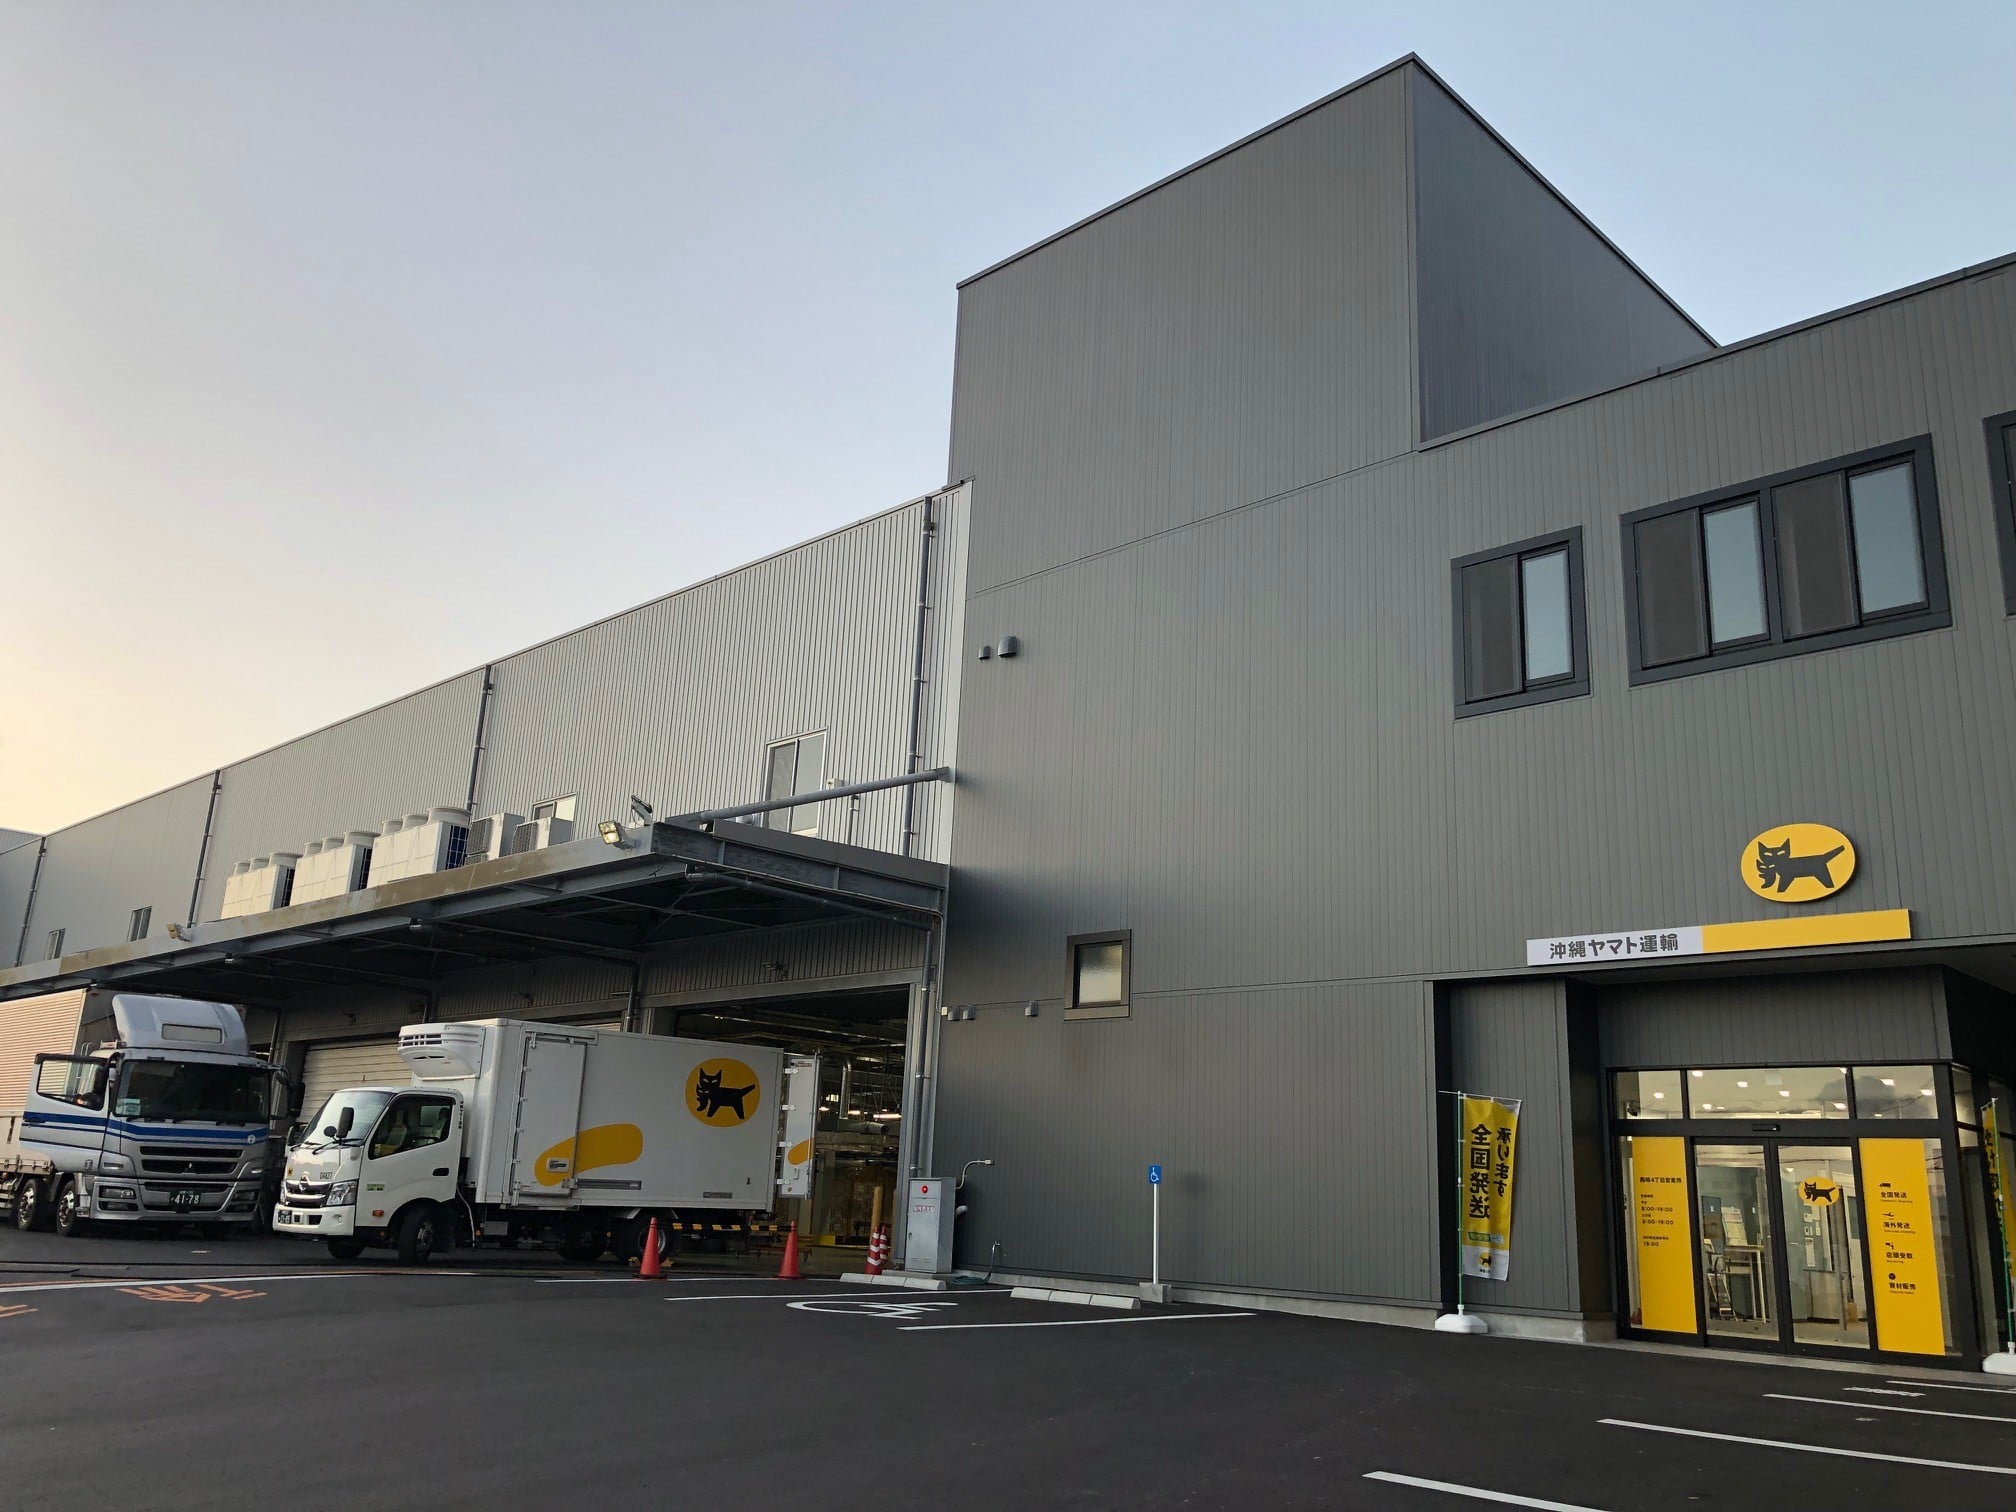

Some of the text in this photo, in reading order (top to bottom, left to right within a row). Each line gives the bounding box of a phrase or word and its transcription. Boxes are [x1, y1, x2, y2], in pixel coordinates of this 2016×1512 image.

[1550, 933, 1679, 960] 沖縄ヤマト運輸
